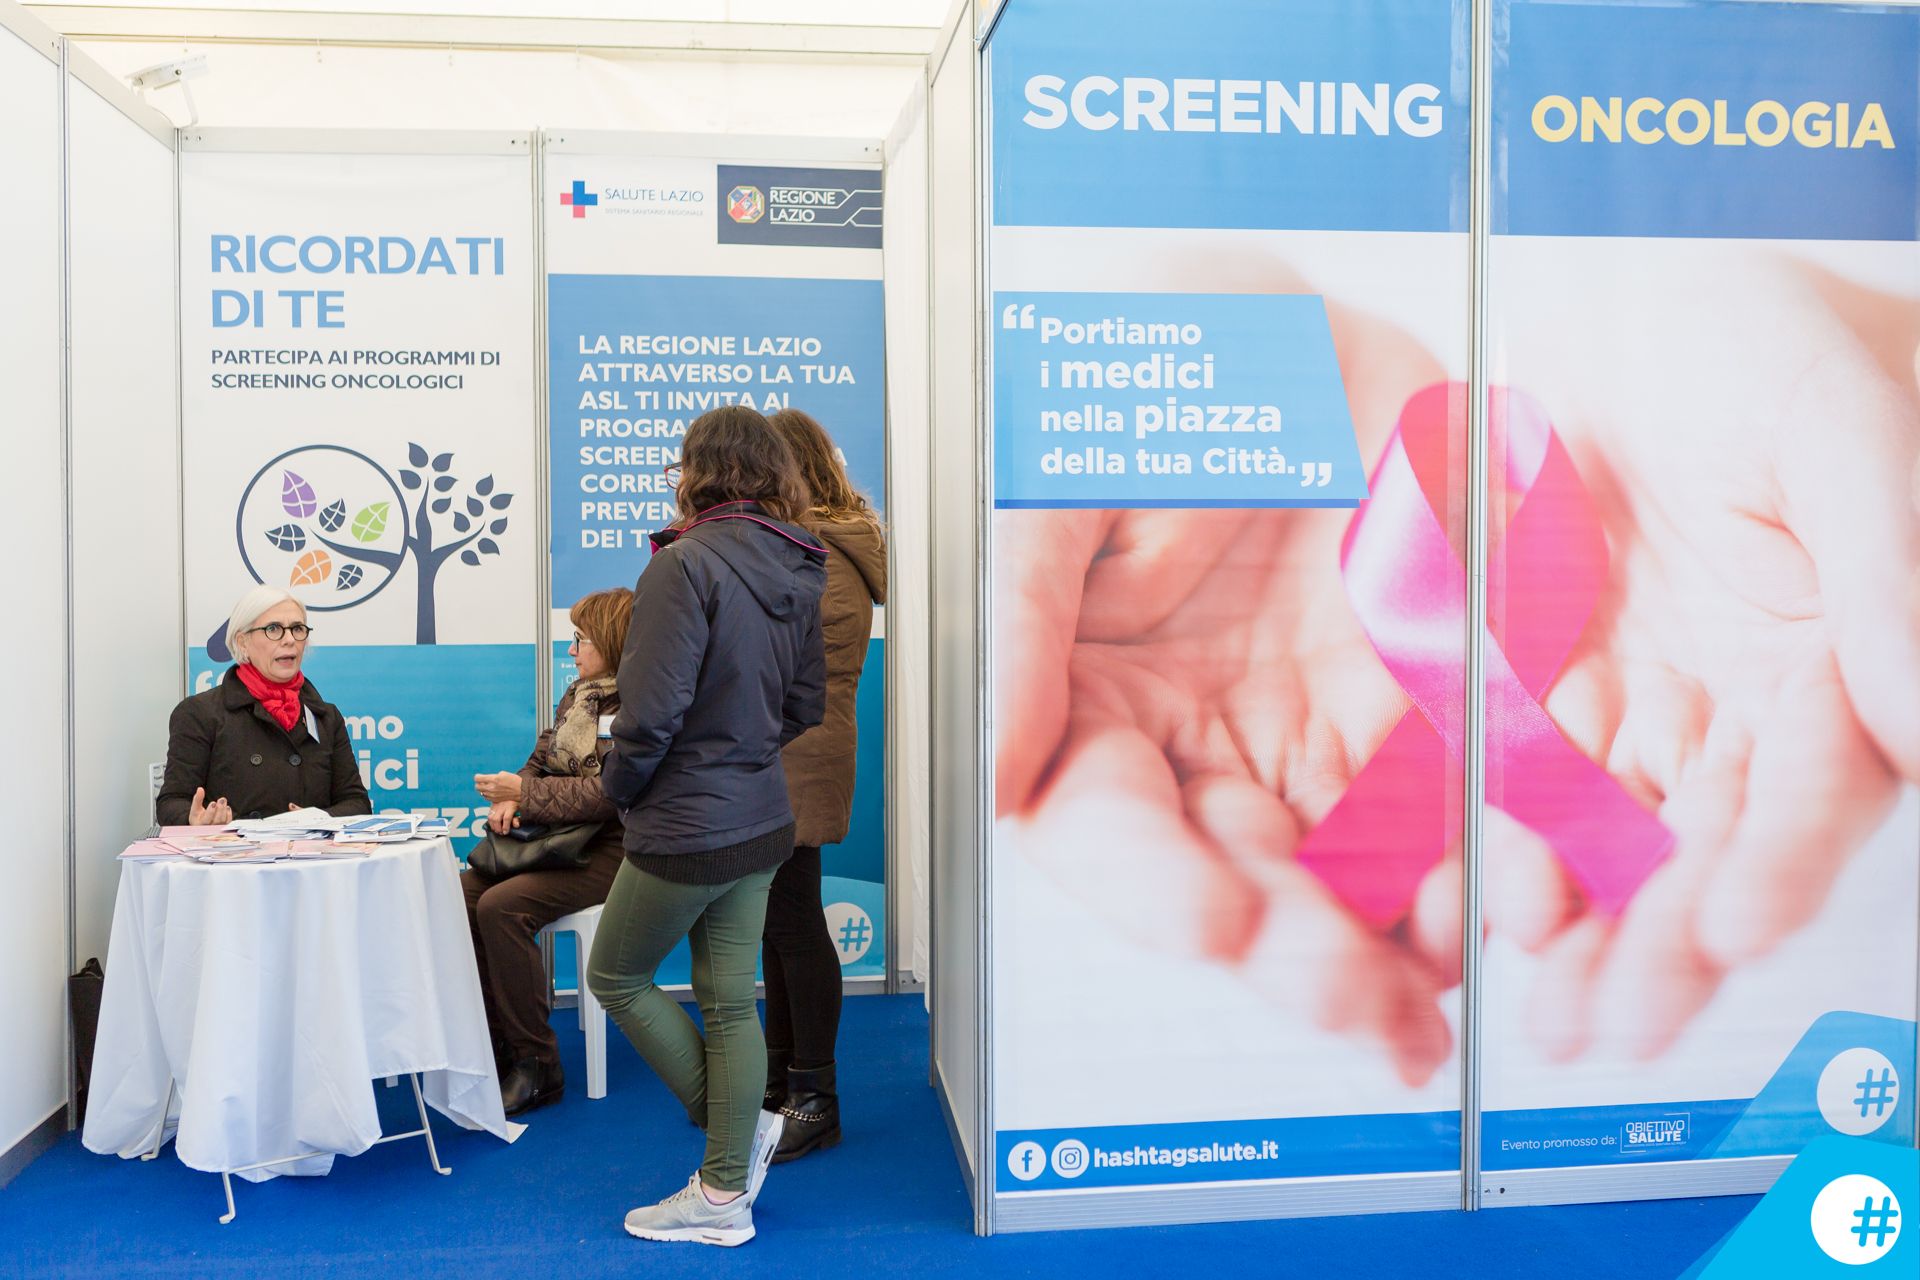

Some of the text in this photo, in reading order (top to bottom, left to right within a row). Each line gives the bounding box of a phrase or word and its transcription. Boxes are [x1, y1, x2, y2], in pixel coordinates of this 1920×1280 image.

[1022, 74, 1443, 138] SCREENING
[1531, 95, 1896, 149] ONCOLOGIA
[605, 188, 704, 202] SALUTE LAZIO
[770, 189, 836, 205] REGIONE
[770, 208, 815, 223] LAZIO
[211, 234, 504, 275] RICORDATI
[211, 290, 345, 328] DI TE
[578, 335, 822, 357] LA REGIONE LAZIO
[211, 350, 500, 367] PARTECIPA AI PROGRAMMI DI
[211, 373, 463, 390] SCREENING ONCOLOGICI
[578, 363, 856, 385] ATTRAVERSO LA TUA
[1041, 354, 1214, 389] i medici
[578, 391, 789, 411] ASL TI INVITA AI
[580, 418, 695, 438] PROGRA
[1041, 397, 1281, 440] nella piazza
[579, 446, 682, 465] SCREEN
[1040, 447, 1125, 475] della
[1136, 449, 1192, 475] tua
[580, 473, 668, 493] CORRE
[581, 501, 677, 521] PREVEN
[581, 530, 623, 549] DEI
[1625, 1120, 1685, 1134] OBIETTIVO
[1501, 1138, 1540, 1150] Evento
[1543, 1136, 1598, 1151] promosso
[1600, 1135, 1617, 1146] da:
[1629, 1131, 1682, 1144] SALUTE
[1094, 1140, 1279, 1168] hashtagsalute.it
